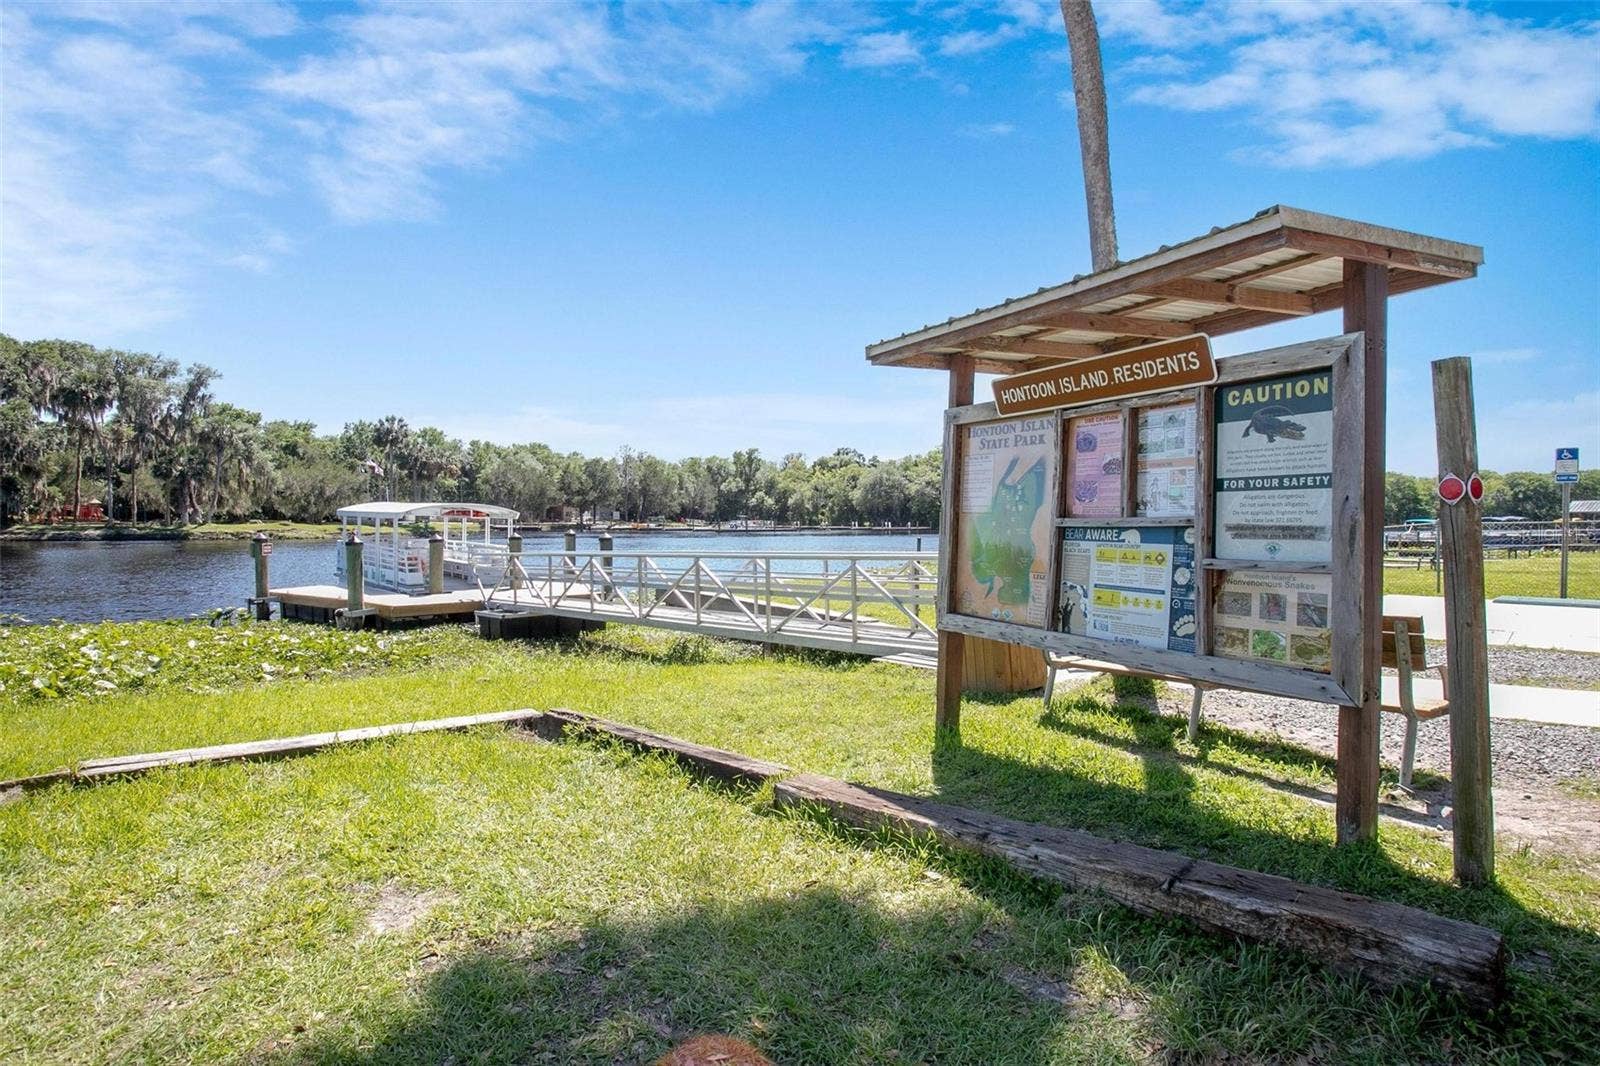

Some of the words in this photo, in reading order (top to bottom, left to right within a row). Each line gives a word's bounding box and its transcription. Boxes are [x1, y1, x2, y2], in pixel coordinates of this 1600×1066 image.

[1001, 379, 1057, 404] HONTOON
[1059, 370, 1109, 395] ISLAND
[1113, 351, 1200, 384] RESIDENTS
[1227, 376, 1329, 407] CAUTION
[1014, 434, 1046, 448] PARK
[1223, 480, 1245, 489] FOR
[1248, 478, 1279, 488] YOUR
[1282, 476, 1330, 487] SAFETY
[1065, 529, 1084, 540] BEAR
[1085, 529, 1119, 540] AWARE
